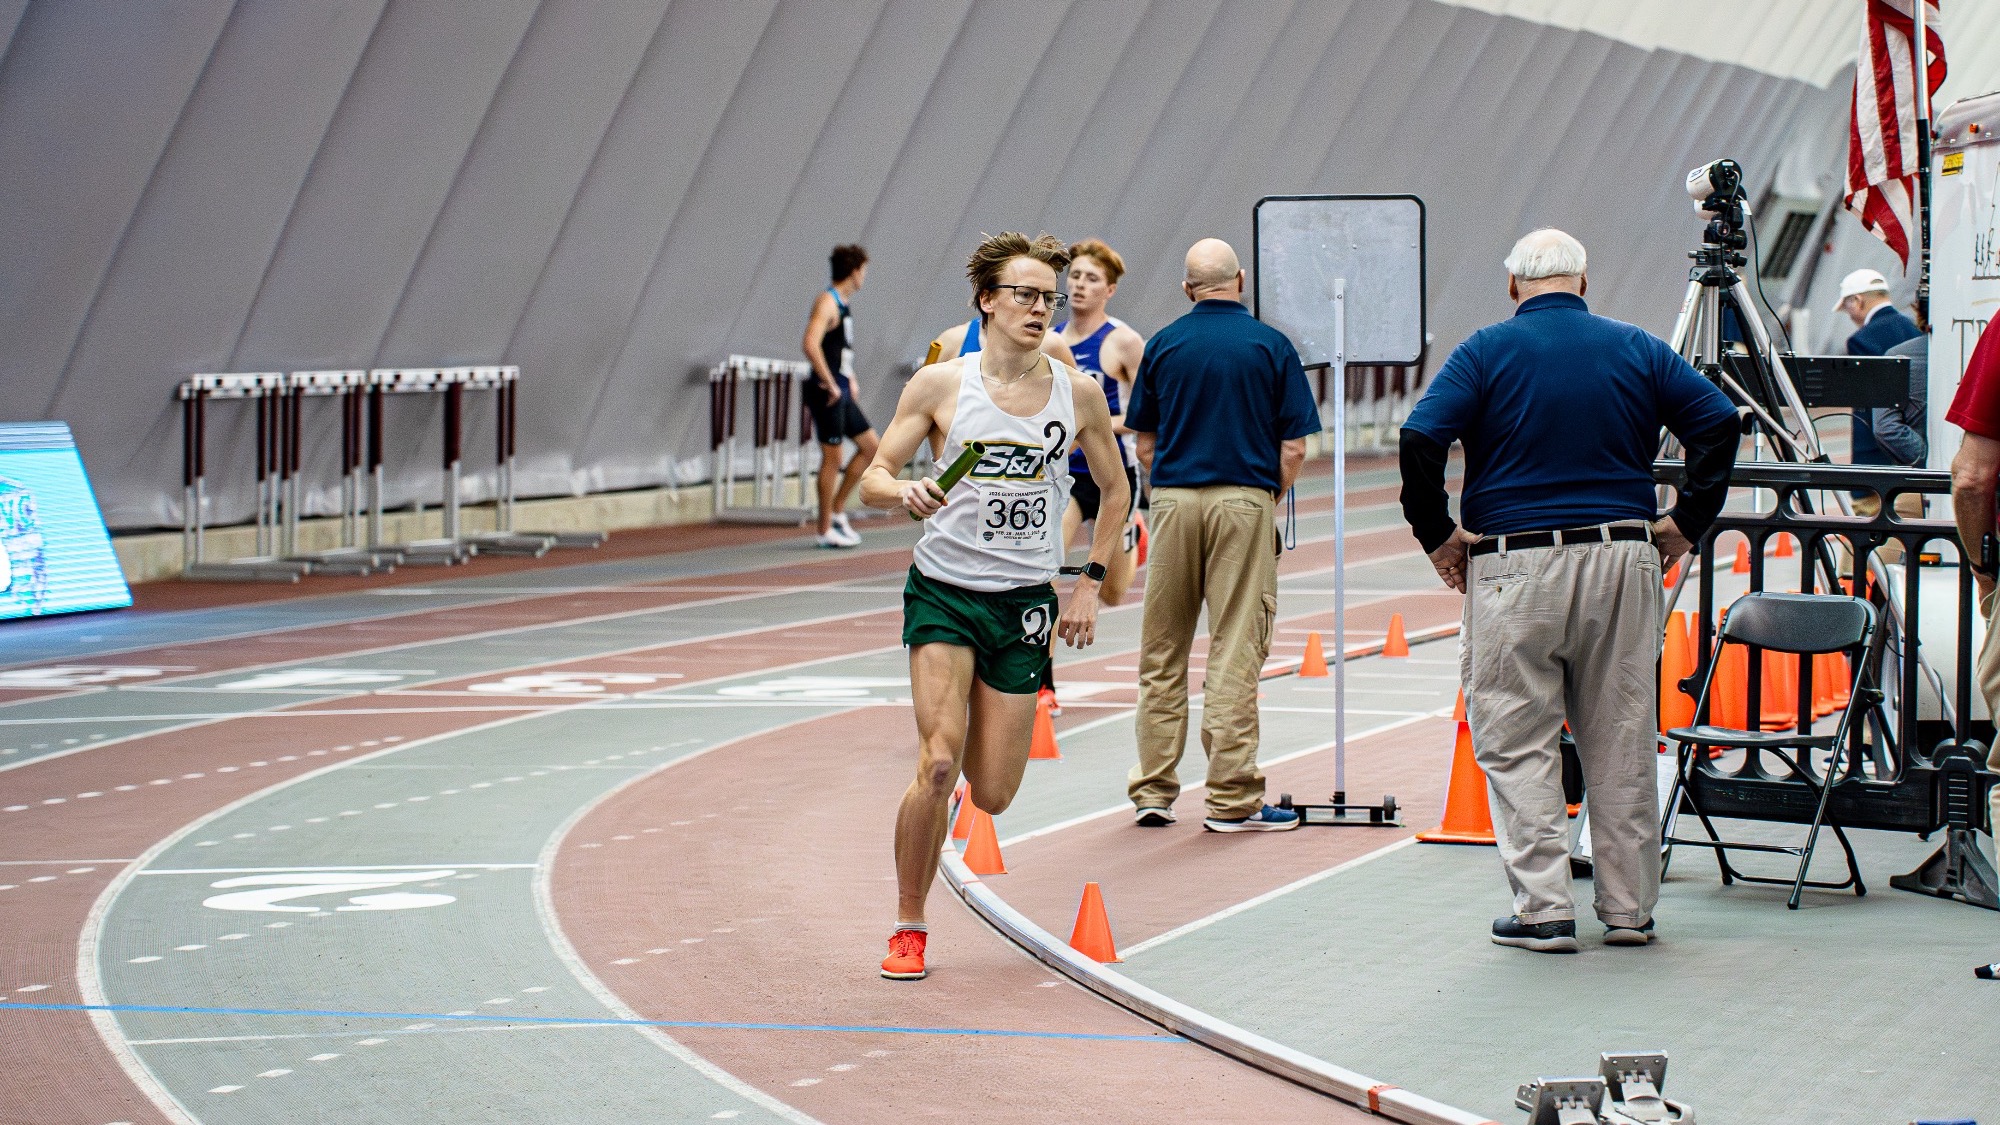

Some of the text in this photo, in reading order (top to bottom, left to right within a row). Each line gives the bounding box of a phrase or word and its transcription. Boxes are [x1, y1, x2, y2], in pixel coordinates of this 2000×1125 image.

[1044, 420, 1067, 464] 2
[986, 496, 1046, 531] 363
[1024, 606, 1047, 646] 2
